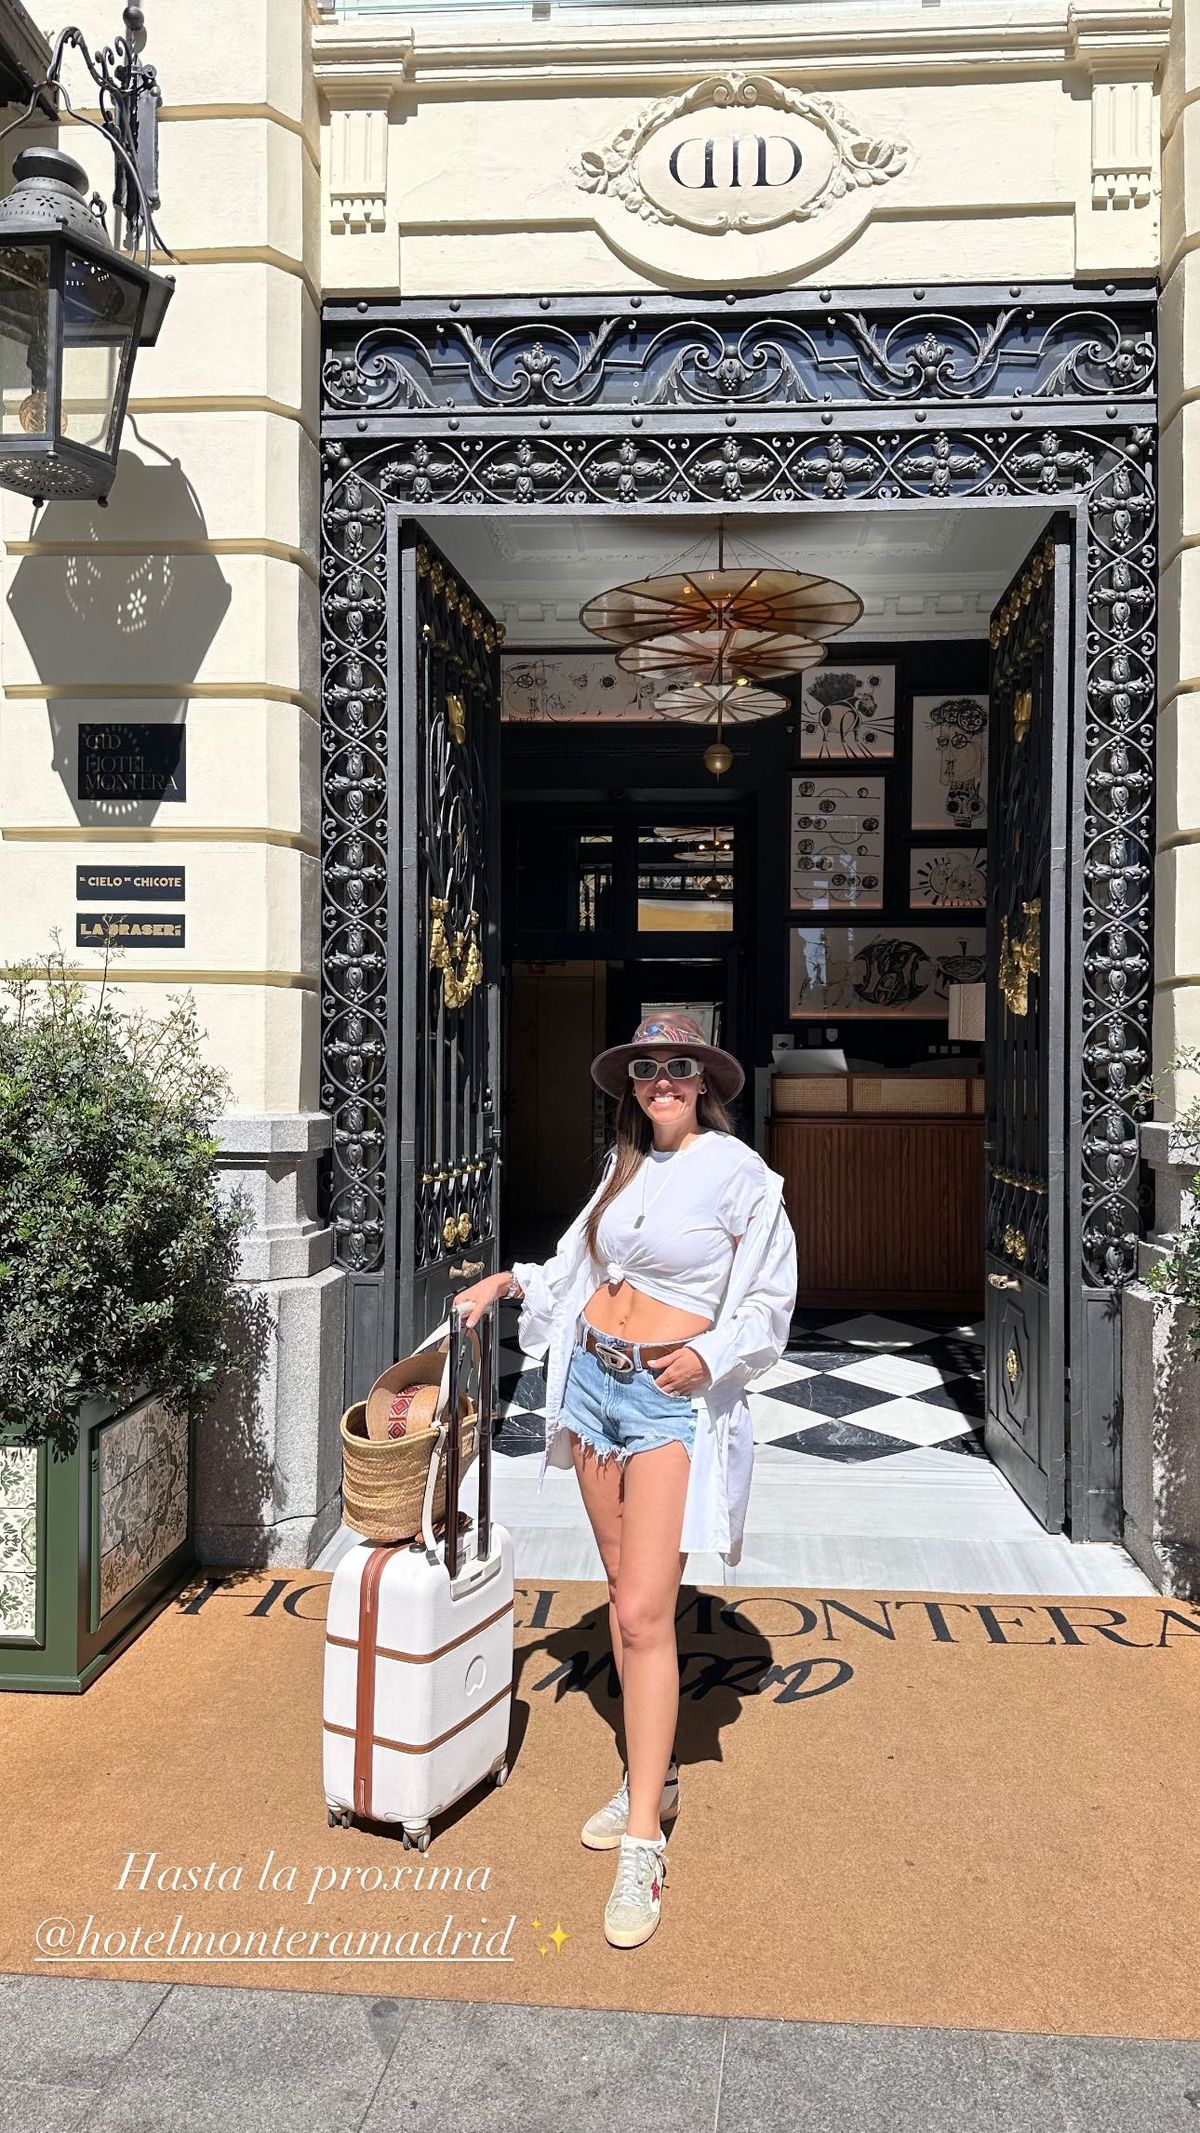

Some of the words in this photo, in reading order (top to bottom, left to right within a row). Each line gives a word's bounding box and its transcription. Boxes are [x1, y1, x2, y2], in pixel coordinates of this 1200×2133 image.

[85, 756, 152, 773] HOTEL
[85, 774, 178, 791] MONTERA
[88, 877, 123, 887] CIELO
[133, 877, 182, 887] CHICOTE
[80, 923, 104, 935] LA
